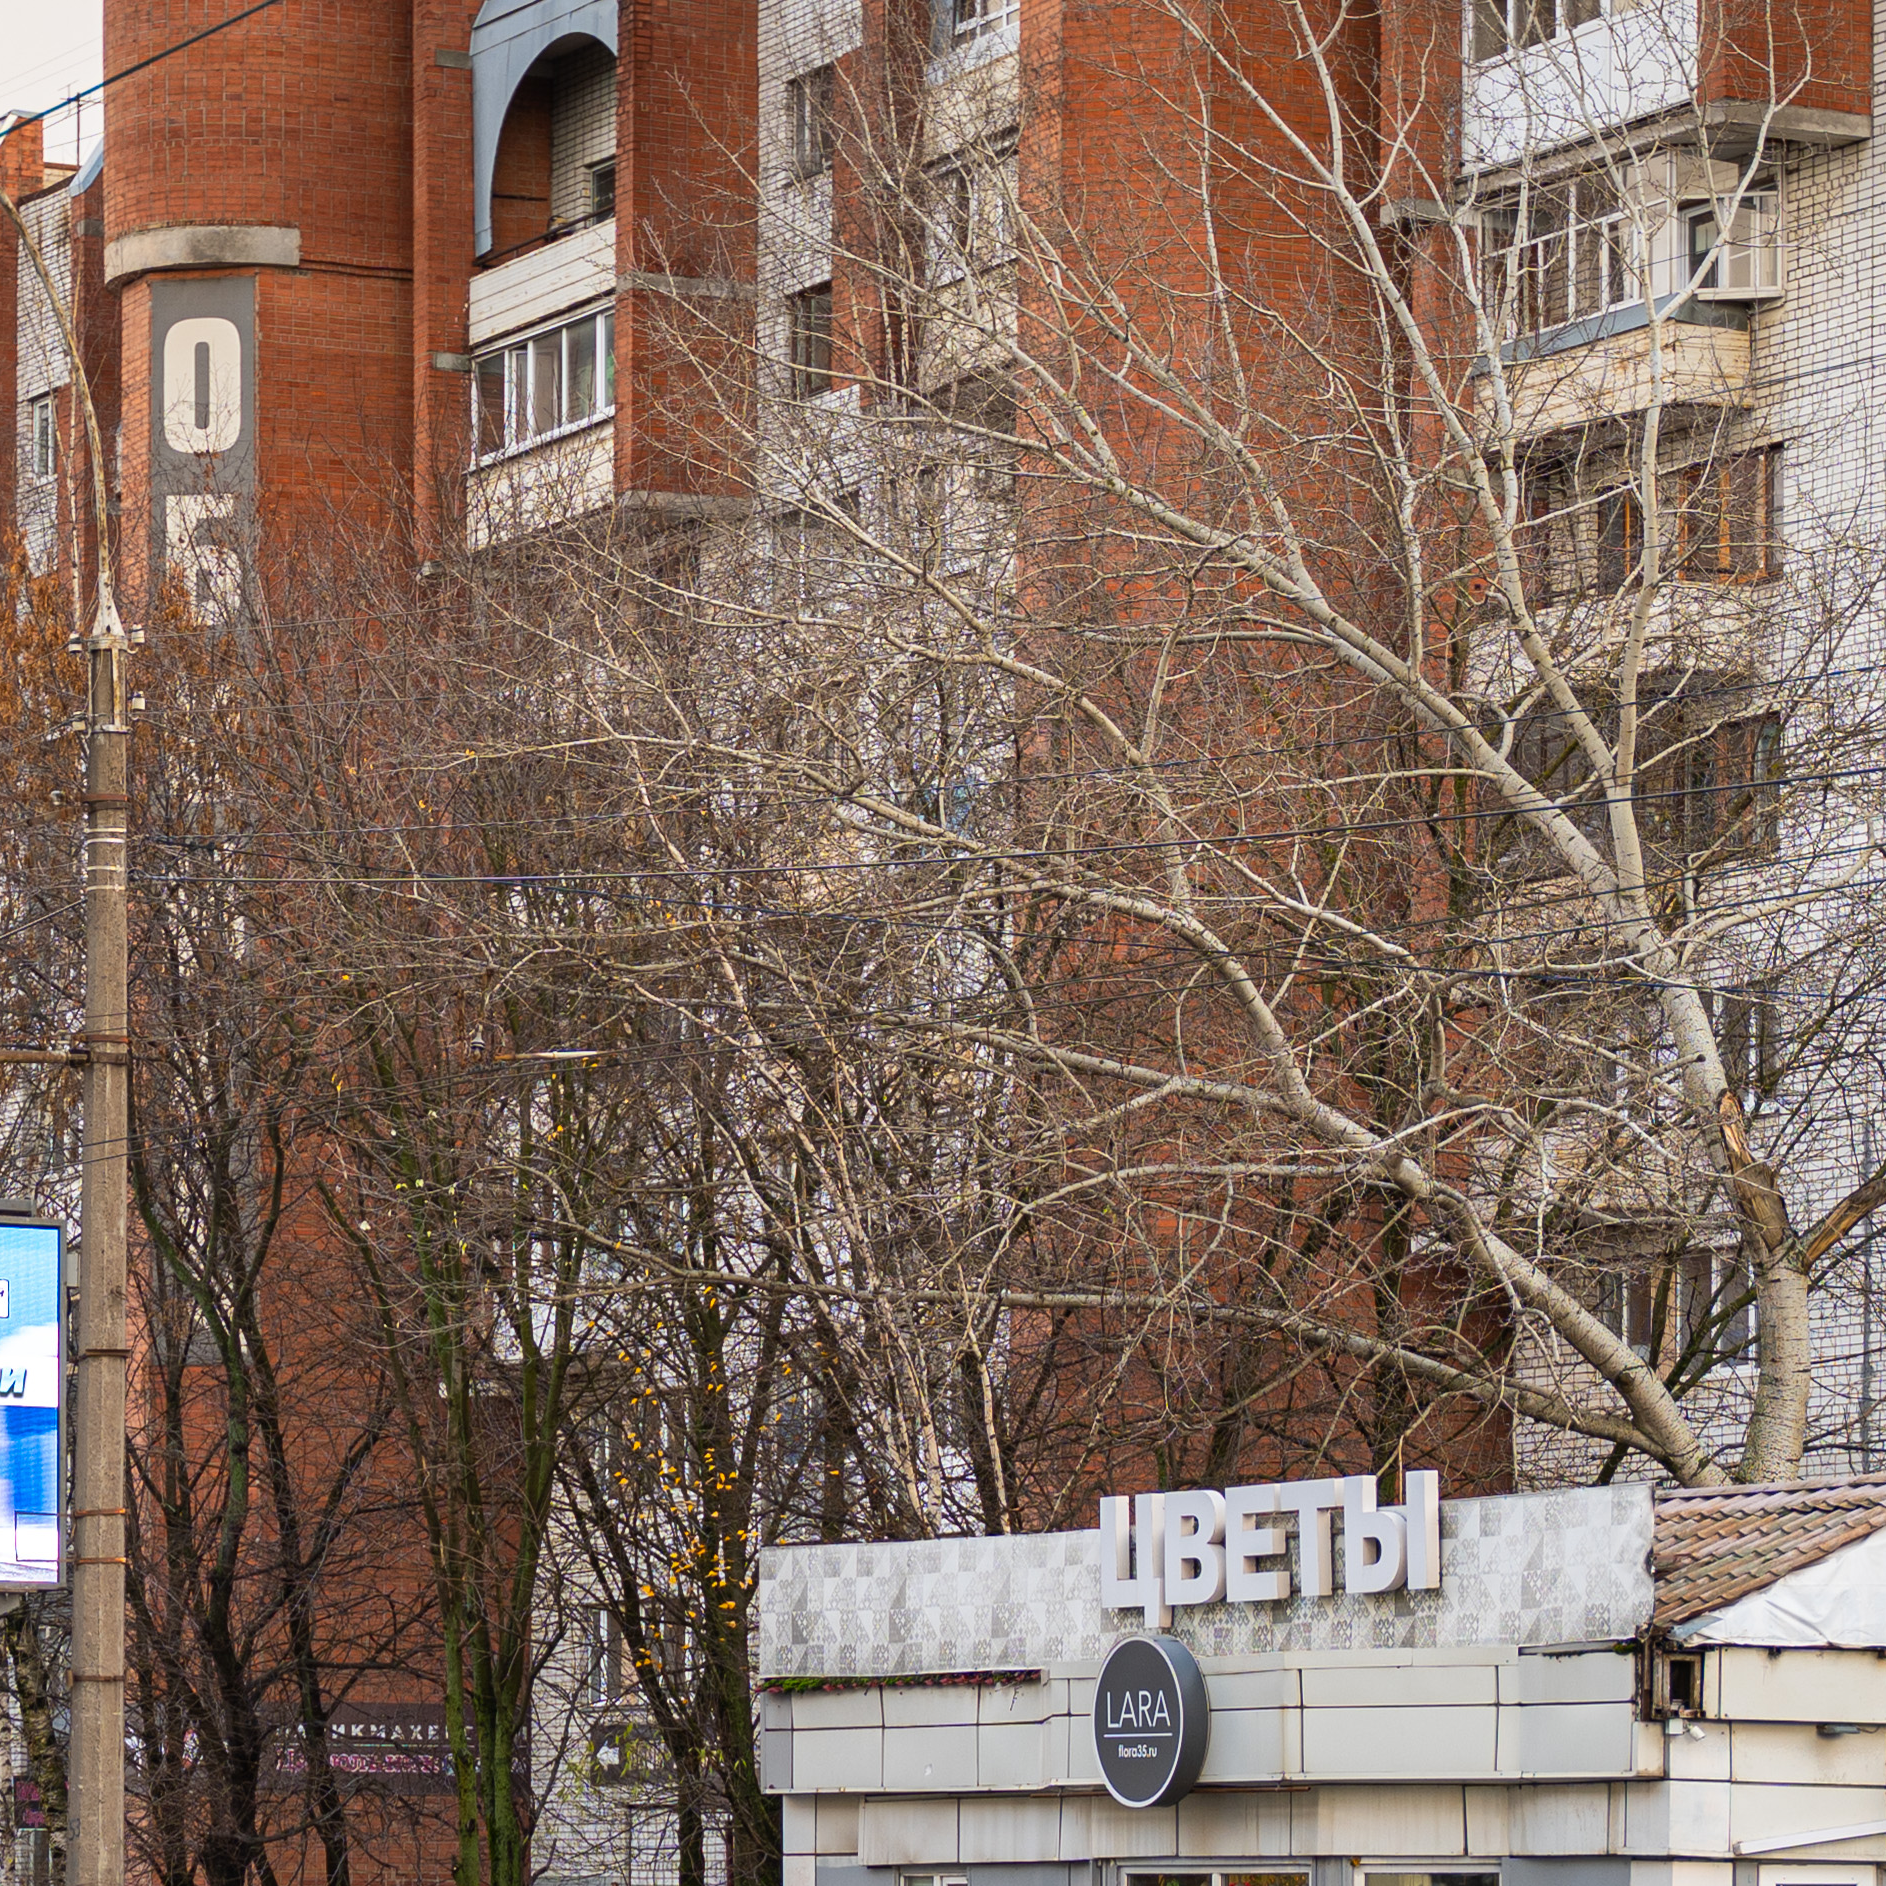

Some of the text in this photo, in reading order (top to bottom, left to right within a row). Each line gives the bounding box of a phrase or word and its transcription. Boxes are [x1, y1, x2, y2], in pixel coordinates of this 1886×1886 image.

[1100, 1470, 1440, 1628] ЦВЕТЫ
[1107, 1690, 1171, 1728] LARA
[1118, 1744, 1158, 1758] flora35.ru
